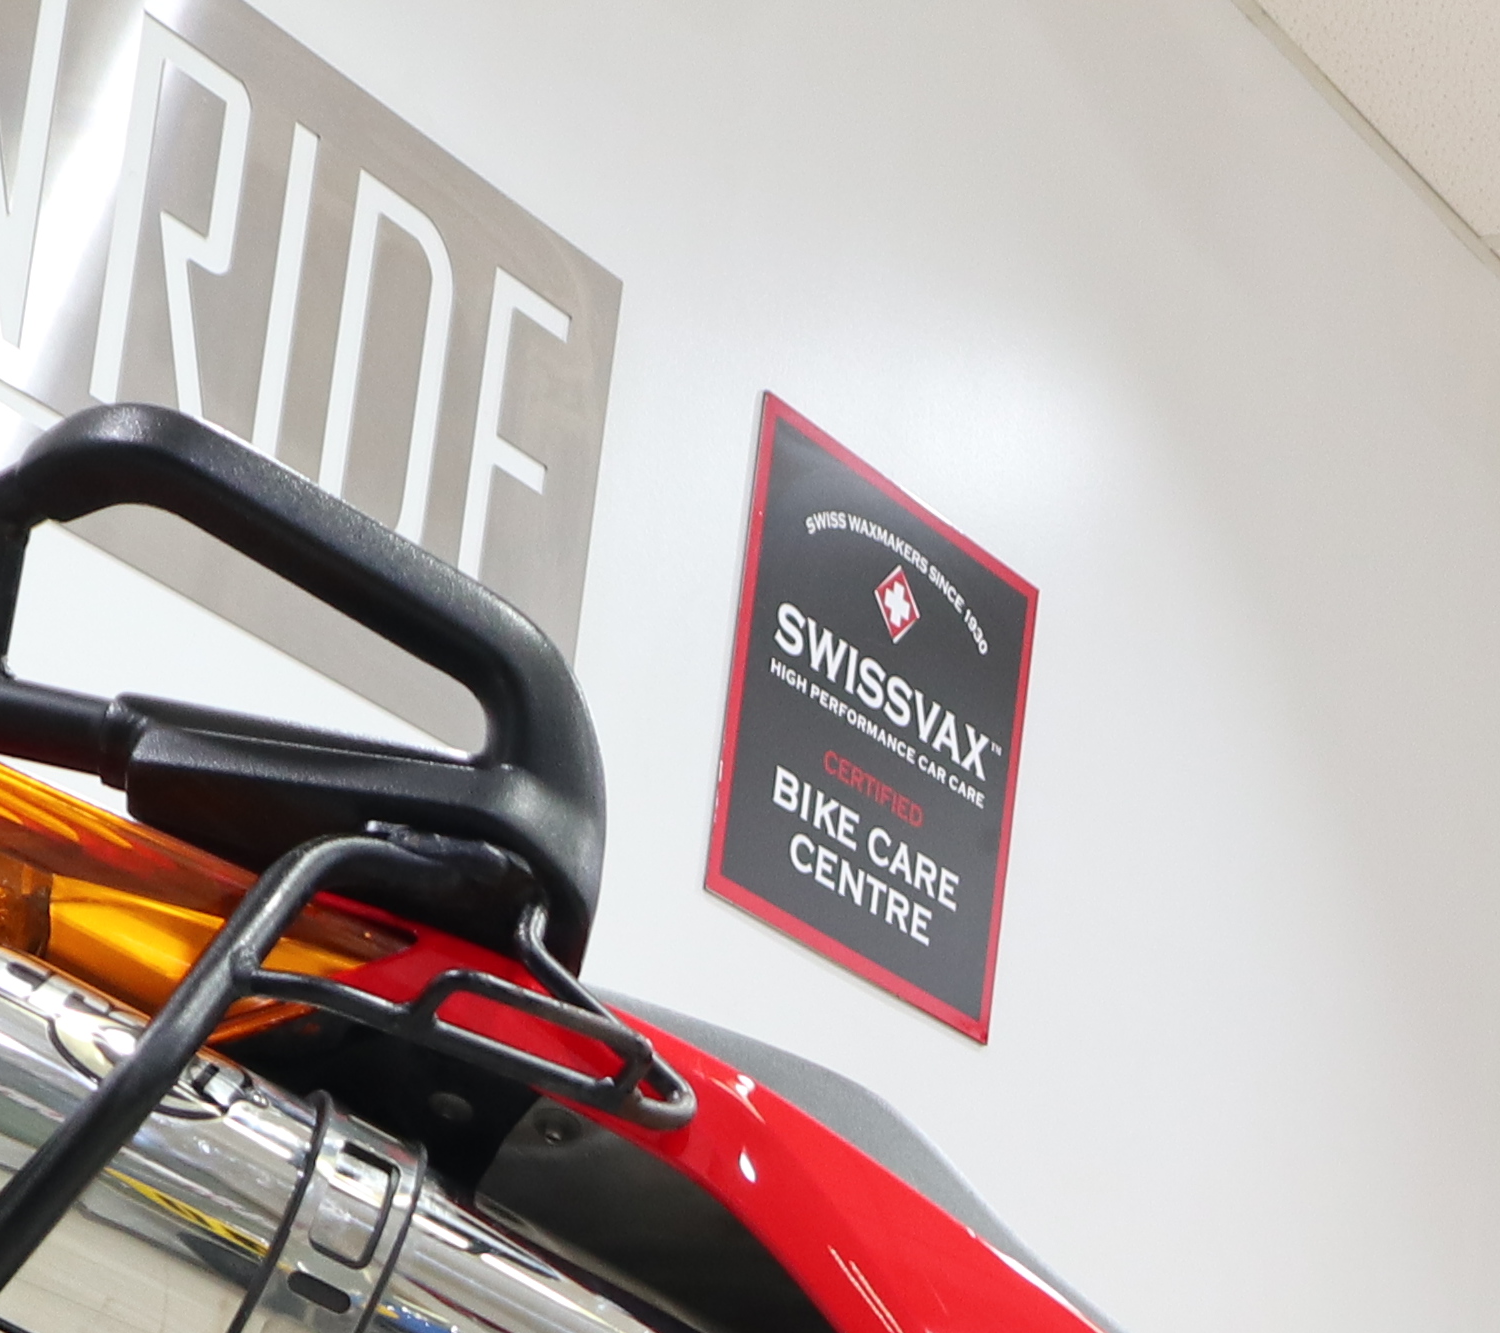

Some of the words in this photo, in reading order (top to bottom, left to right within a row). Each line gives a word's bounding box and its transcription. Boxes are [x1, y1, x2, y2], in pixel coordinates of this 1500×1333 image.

[88, 10, 571, 580] RIDE
[805, 511, 847, 534] SWISS
[847, 513, 929, 574] WAXMAKERS
[928, 567, 965, 614] SINCE
[964, 609, 988, 655] 1930
[770, 657, 807, 694] HIGH
[810, 683, 916, 764] PERFORMANCE
[918, 755, 946, 786] CAR
[949, 776, 986, 809] CARE
[774, 602, 990, 782] SWISSVAX
[772, 765, 860, 851] BIKE
[867, 827, 960, 913] CARE
[823, 750, 925, 828] CERTIFIED
[789, 833, 933, 946] CENTRE
